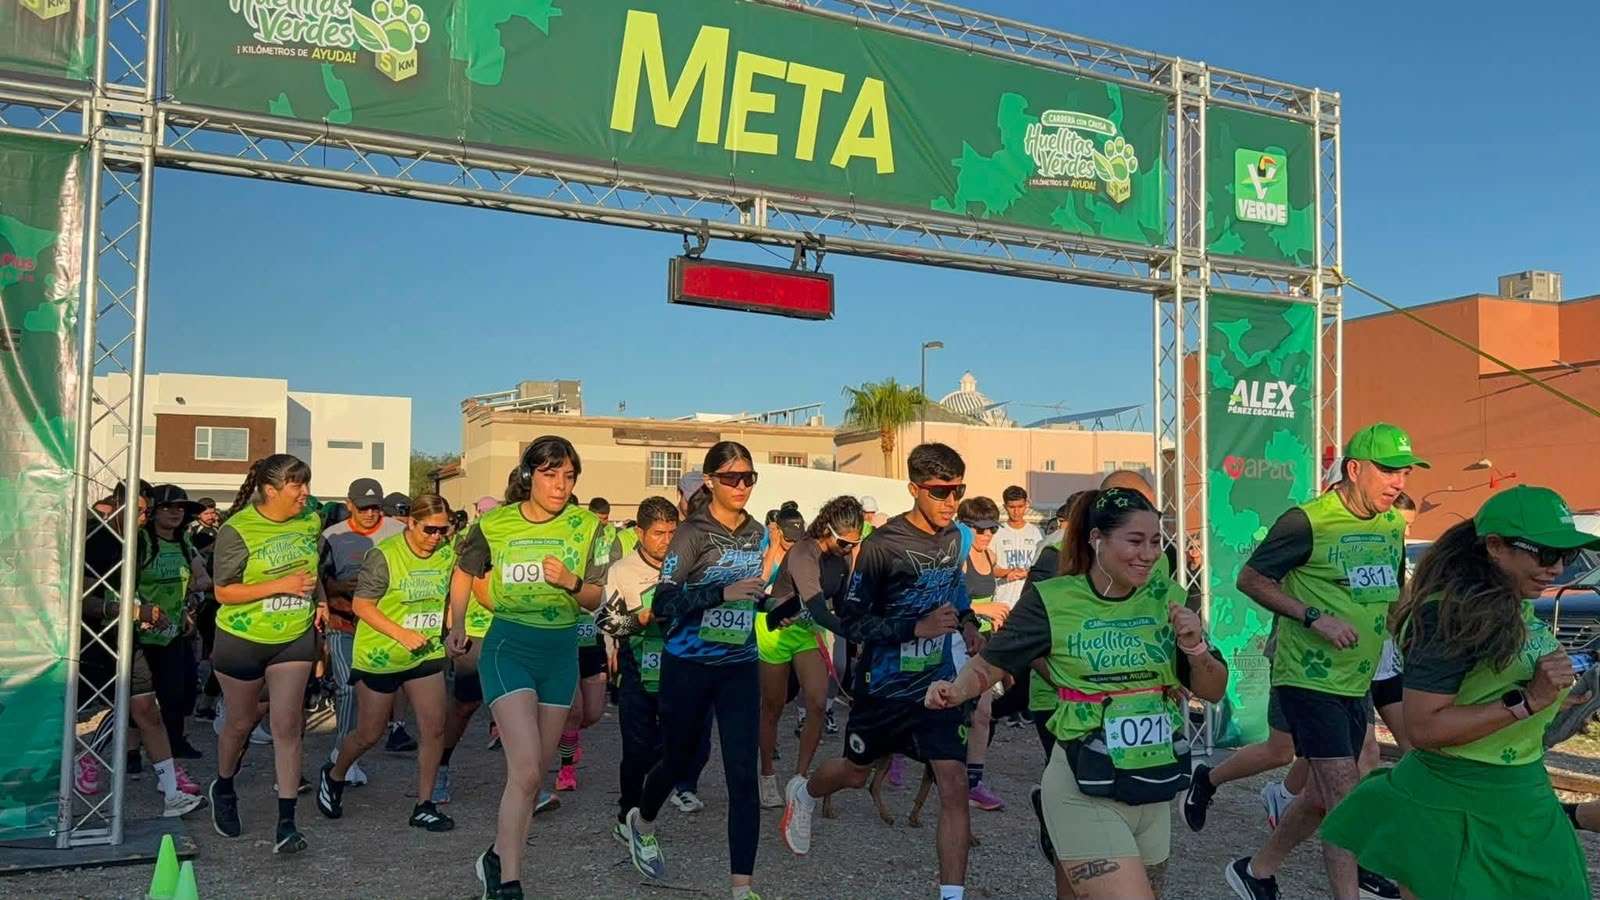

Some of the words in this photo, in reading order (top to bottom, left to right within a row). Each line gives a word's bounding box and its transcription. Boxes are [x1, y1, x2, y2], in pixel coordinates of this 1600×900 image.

[253, 6, 354, 47] Verdes
[297, 48, 309, 57] DE
[311, 47, 357, 63] AYUDA!
[398, 59, 415, 72] KM
[610, 9, 895, 175] META
[1024, 123, 1094, 166] Huellitas
[1037, 149, 1096, 178] Verdes
[1237, 198, 1287, 225] VERDE
[1228, 379, 1296, 411] ALEX
[1253, 408, 1295, 418] ESCALANTE
[512, 563, 541, 583] 09
[412, 613, 437, 628] 176
[576, 624, 594, 637] 55
[709, 610, 746, 629] 394
[911, 638, 937, 657] 10
[1067, 631, 1141, 659] Huellitas
[1086, 648, 1147, 672] Verdes
[1120, 715, 1163, 747] 021
